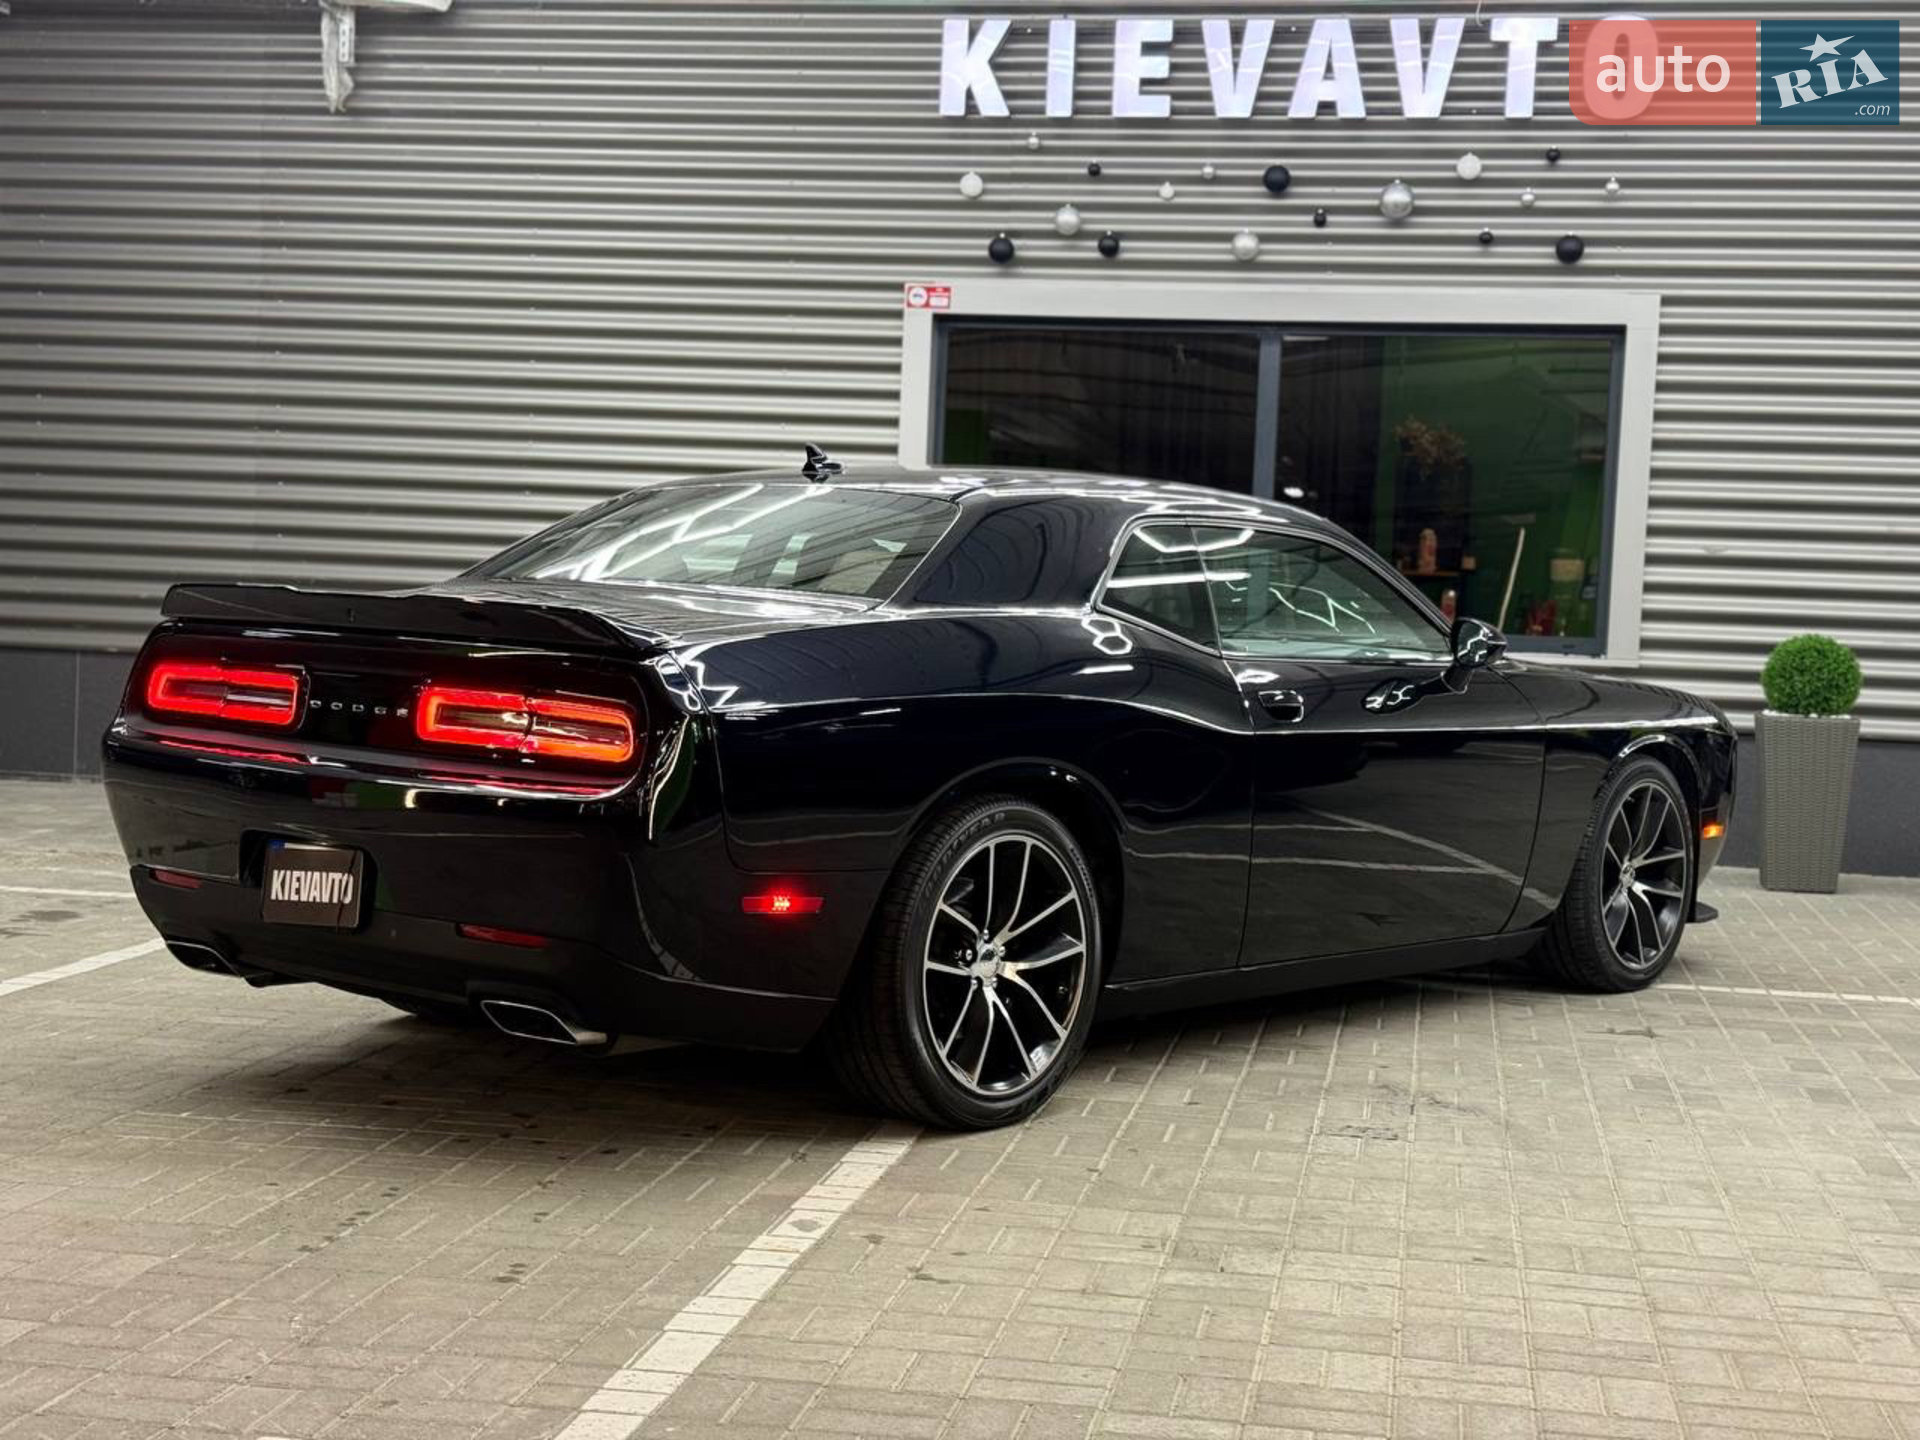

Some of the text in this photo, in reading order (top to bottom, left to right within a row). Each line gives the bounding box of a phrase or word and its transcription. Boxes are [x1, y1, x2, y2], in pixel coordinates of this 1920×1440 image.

[939, 13, 1659, 120] KIEVAVTO
[310, 699, 409, 718] DODGE
[270, 869, 354, 905] KIEVAVTO
